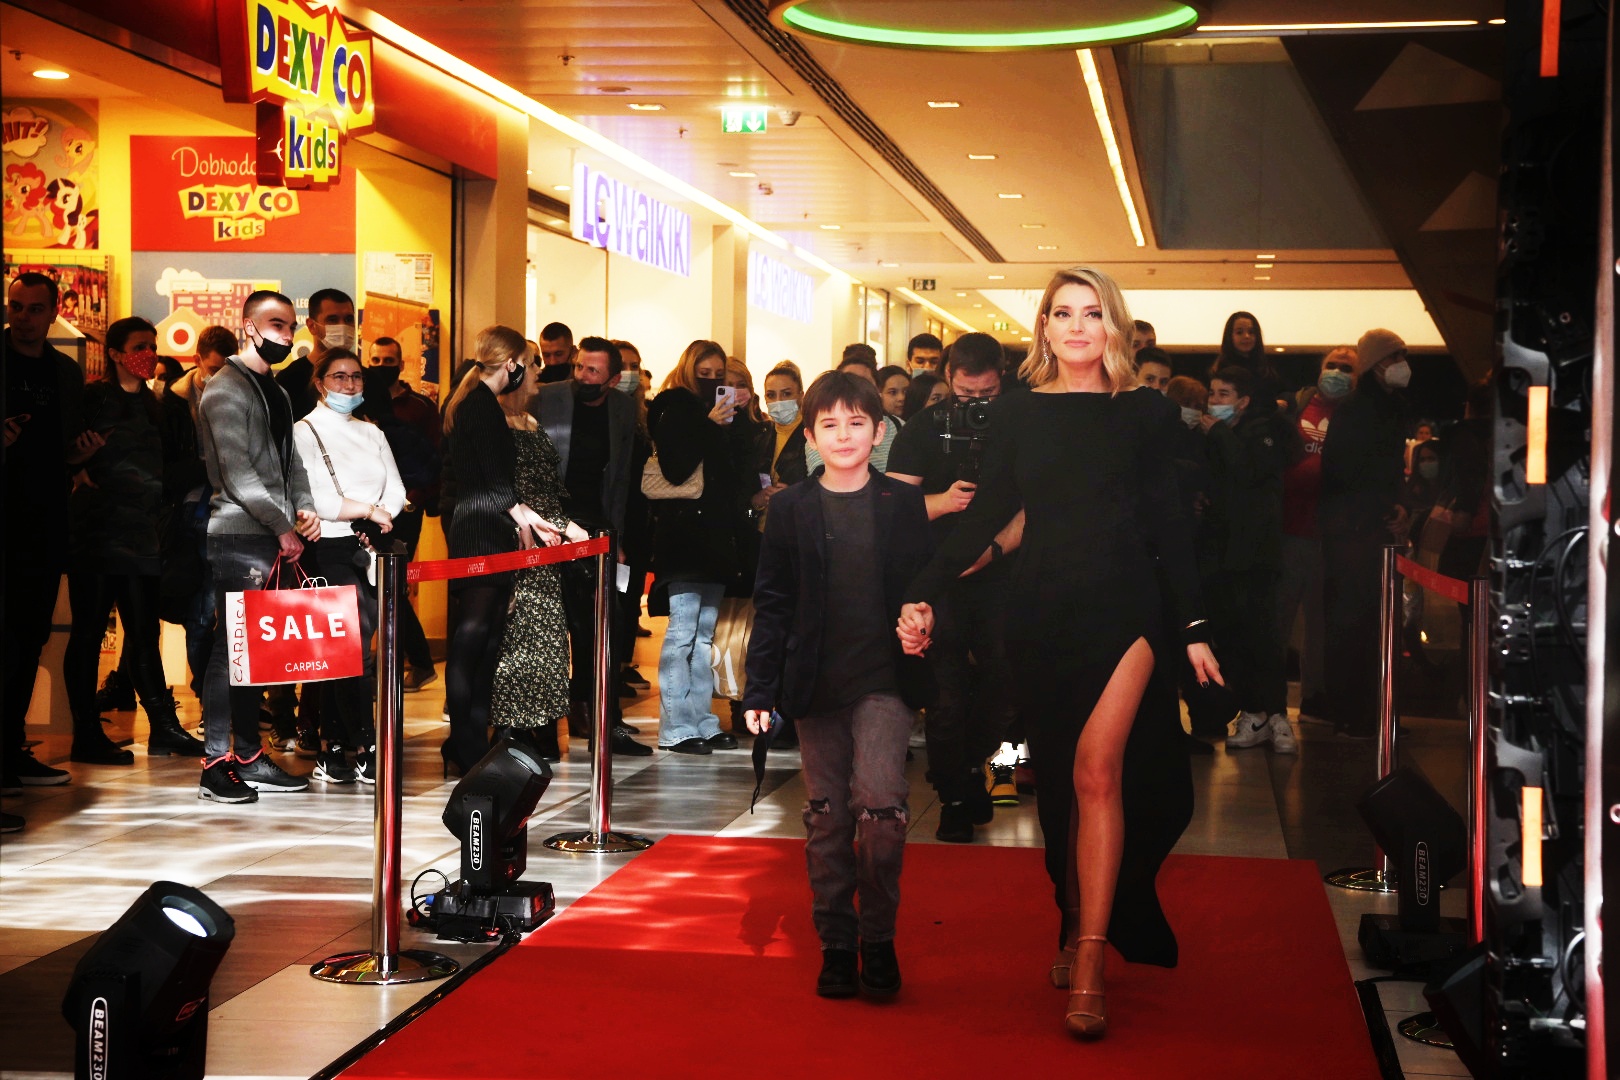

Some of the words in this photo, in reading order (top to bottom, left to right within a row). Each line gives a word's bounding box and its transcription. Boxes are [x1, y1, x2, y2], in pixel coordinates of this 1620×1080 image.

[256, 2, 326, 97] DEXY
[332, 45, 367, 115] CO
[171, 146, 257, 177] Dobrodo
[289, 114, 337, 171] kids
[188, 191, 251, 212] DEXY
[258, 191, 293, 212] CO
[217, 221, 265, 238] kids
[232, 597, 245, 683] CARPISA
[258, 612, 346, 642] SALE
[284, 660, 329, 673] CARPISA
[472, 817, 480, 864] BEAM230
[1418, 849, 1427, 899] BEAM230
[93, 1008, 105, 1080] BEAM230
